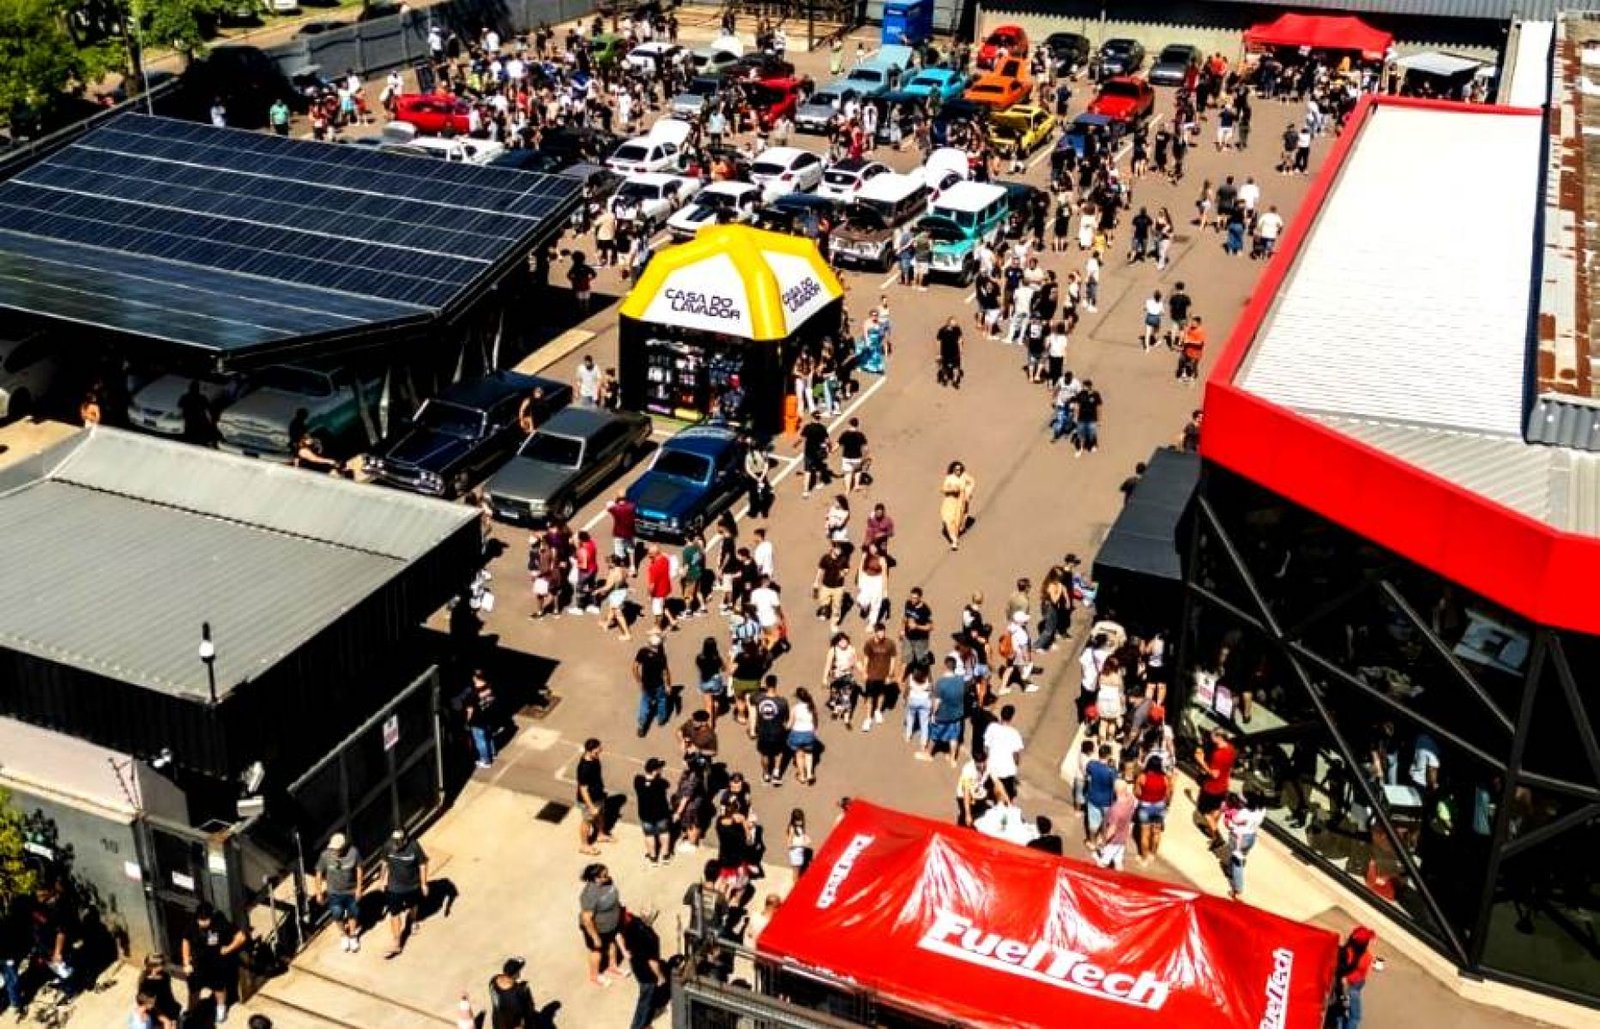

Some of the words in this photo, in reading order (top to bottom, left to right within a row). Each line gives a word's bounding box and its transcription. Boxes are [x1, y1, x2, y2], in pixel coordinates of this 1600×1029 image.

[665, 288, 706, 305] CASA
[710, 295, 733, 308] DO
[671, 298, 740, 320] LAVADOR
[918, 909, 1168, 1010] FuelTech
